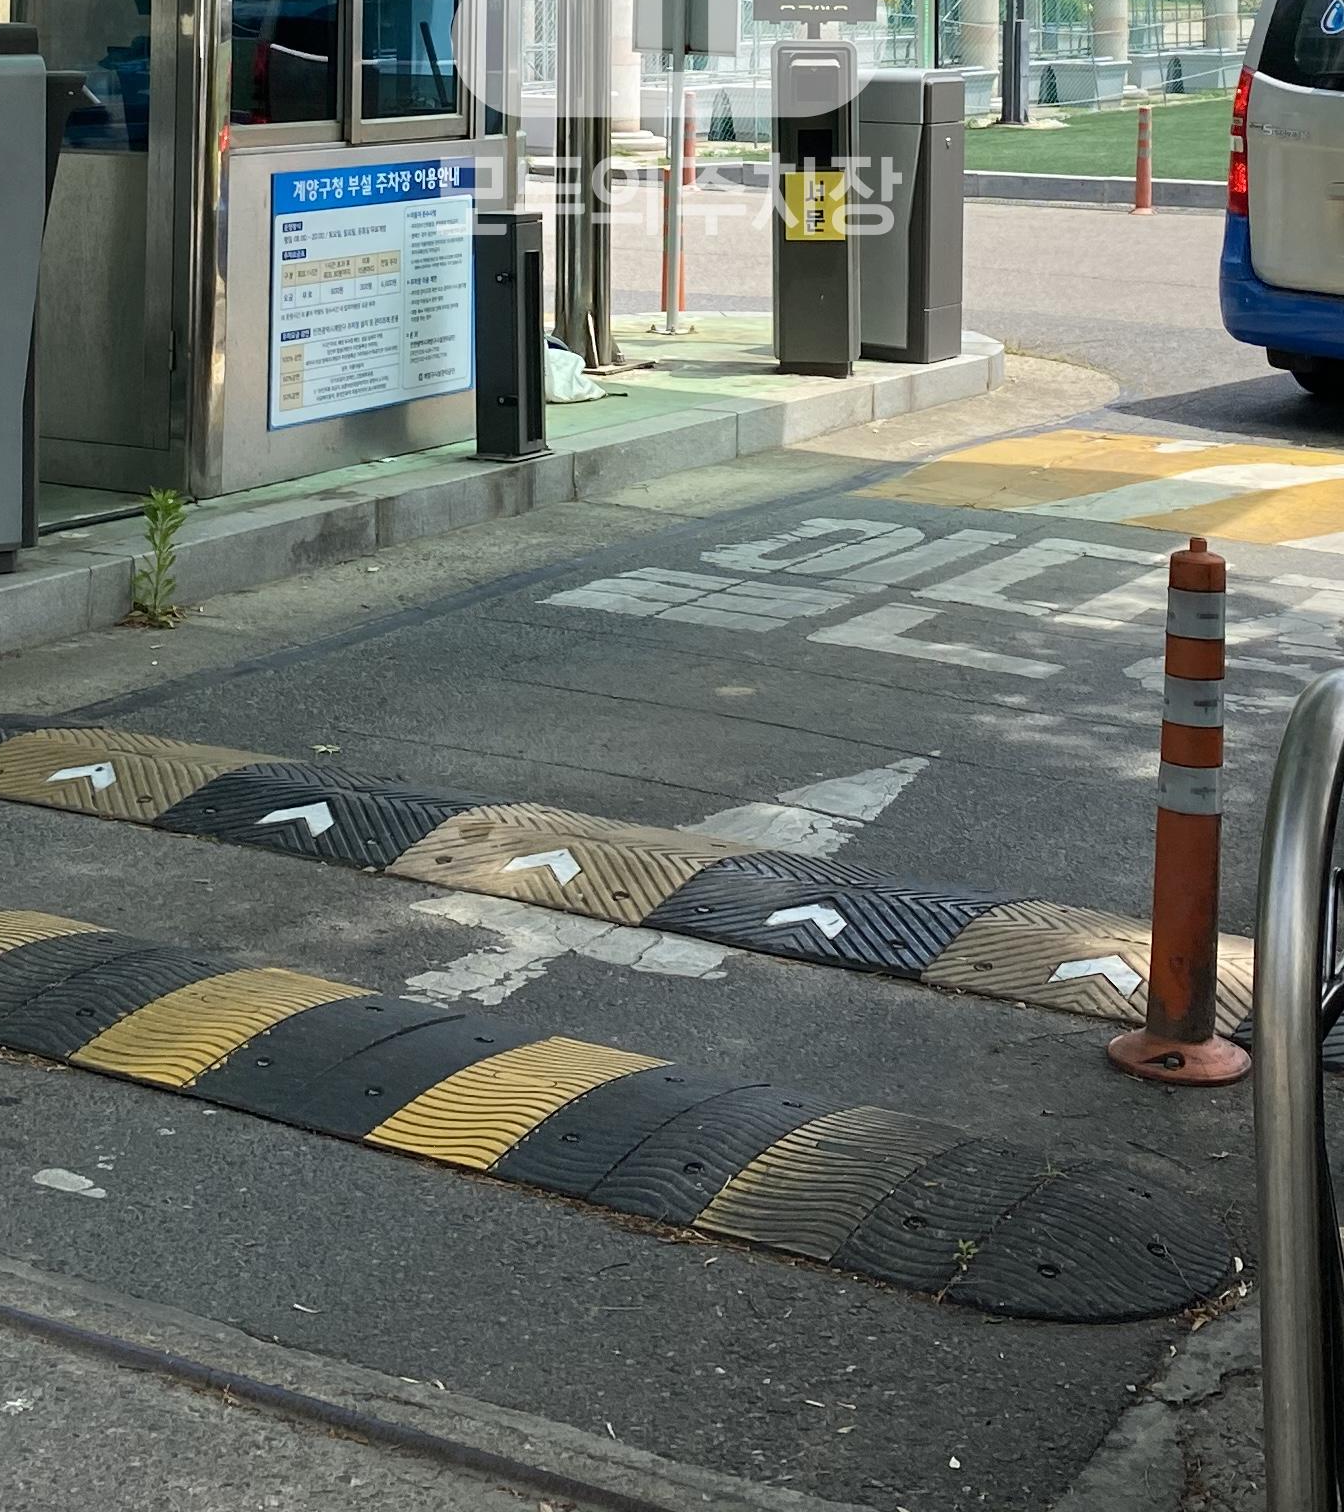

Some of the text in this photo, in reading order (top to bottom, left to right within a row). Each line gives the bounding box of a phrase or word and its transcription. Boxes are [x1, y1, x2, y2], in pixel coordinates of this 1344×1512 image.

[292, 166, 460, 202] 계양구청 부설 주차장 이용안내
